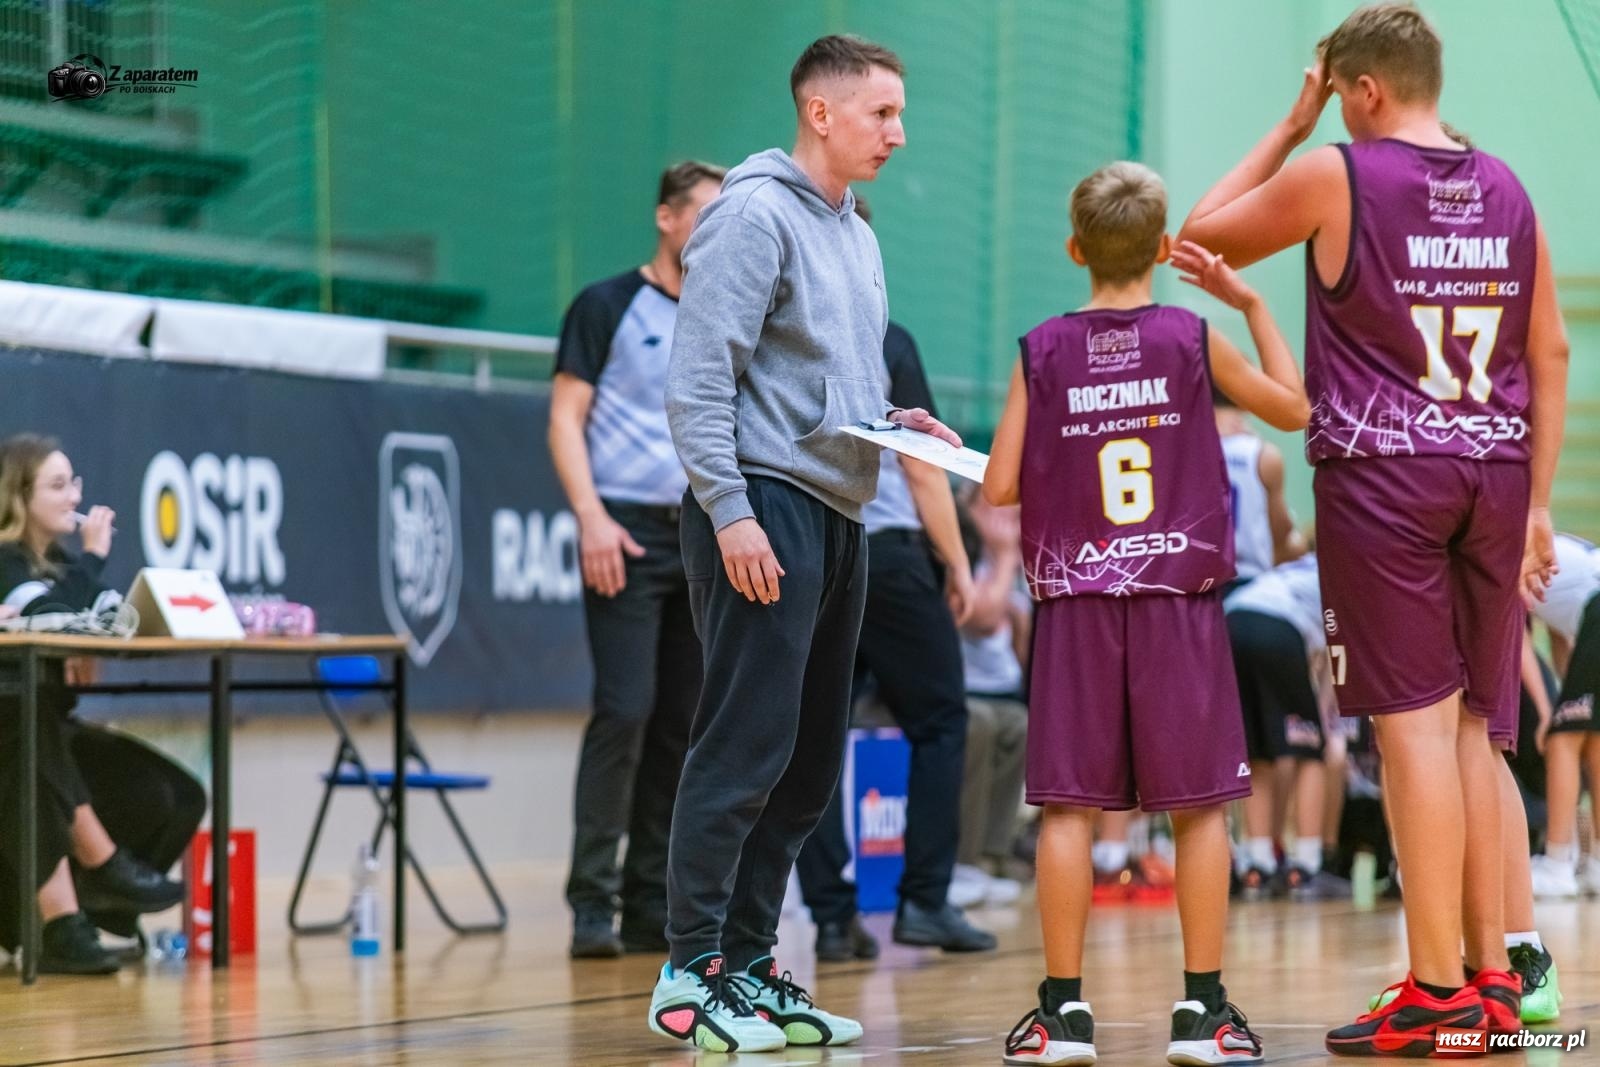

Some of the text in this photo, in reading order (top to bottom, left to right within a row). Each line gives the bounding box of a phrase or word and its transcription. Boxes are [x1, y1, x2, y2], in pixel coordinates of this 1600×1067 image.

[1406, 232, 1510, 269] WOŹNIAK
[1410, 304, 1504, 404] 17
[1067, 377, 1170, 414] ROCZNIAK
[1097, 437, 1155, 526] 6
[1075, 531, 1189, 564] AXIS3D
